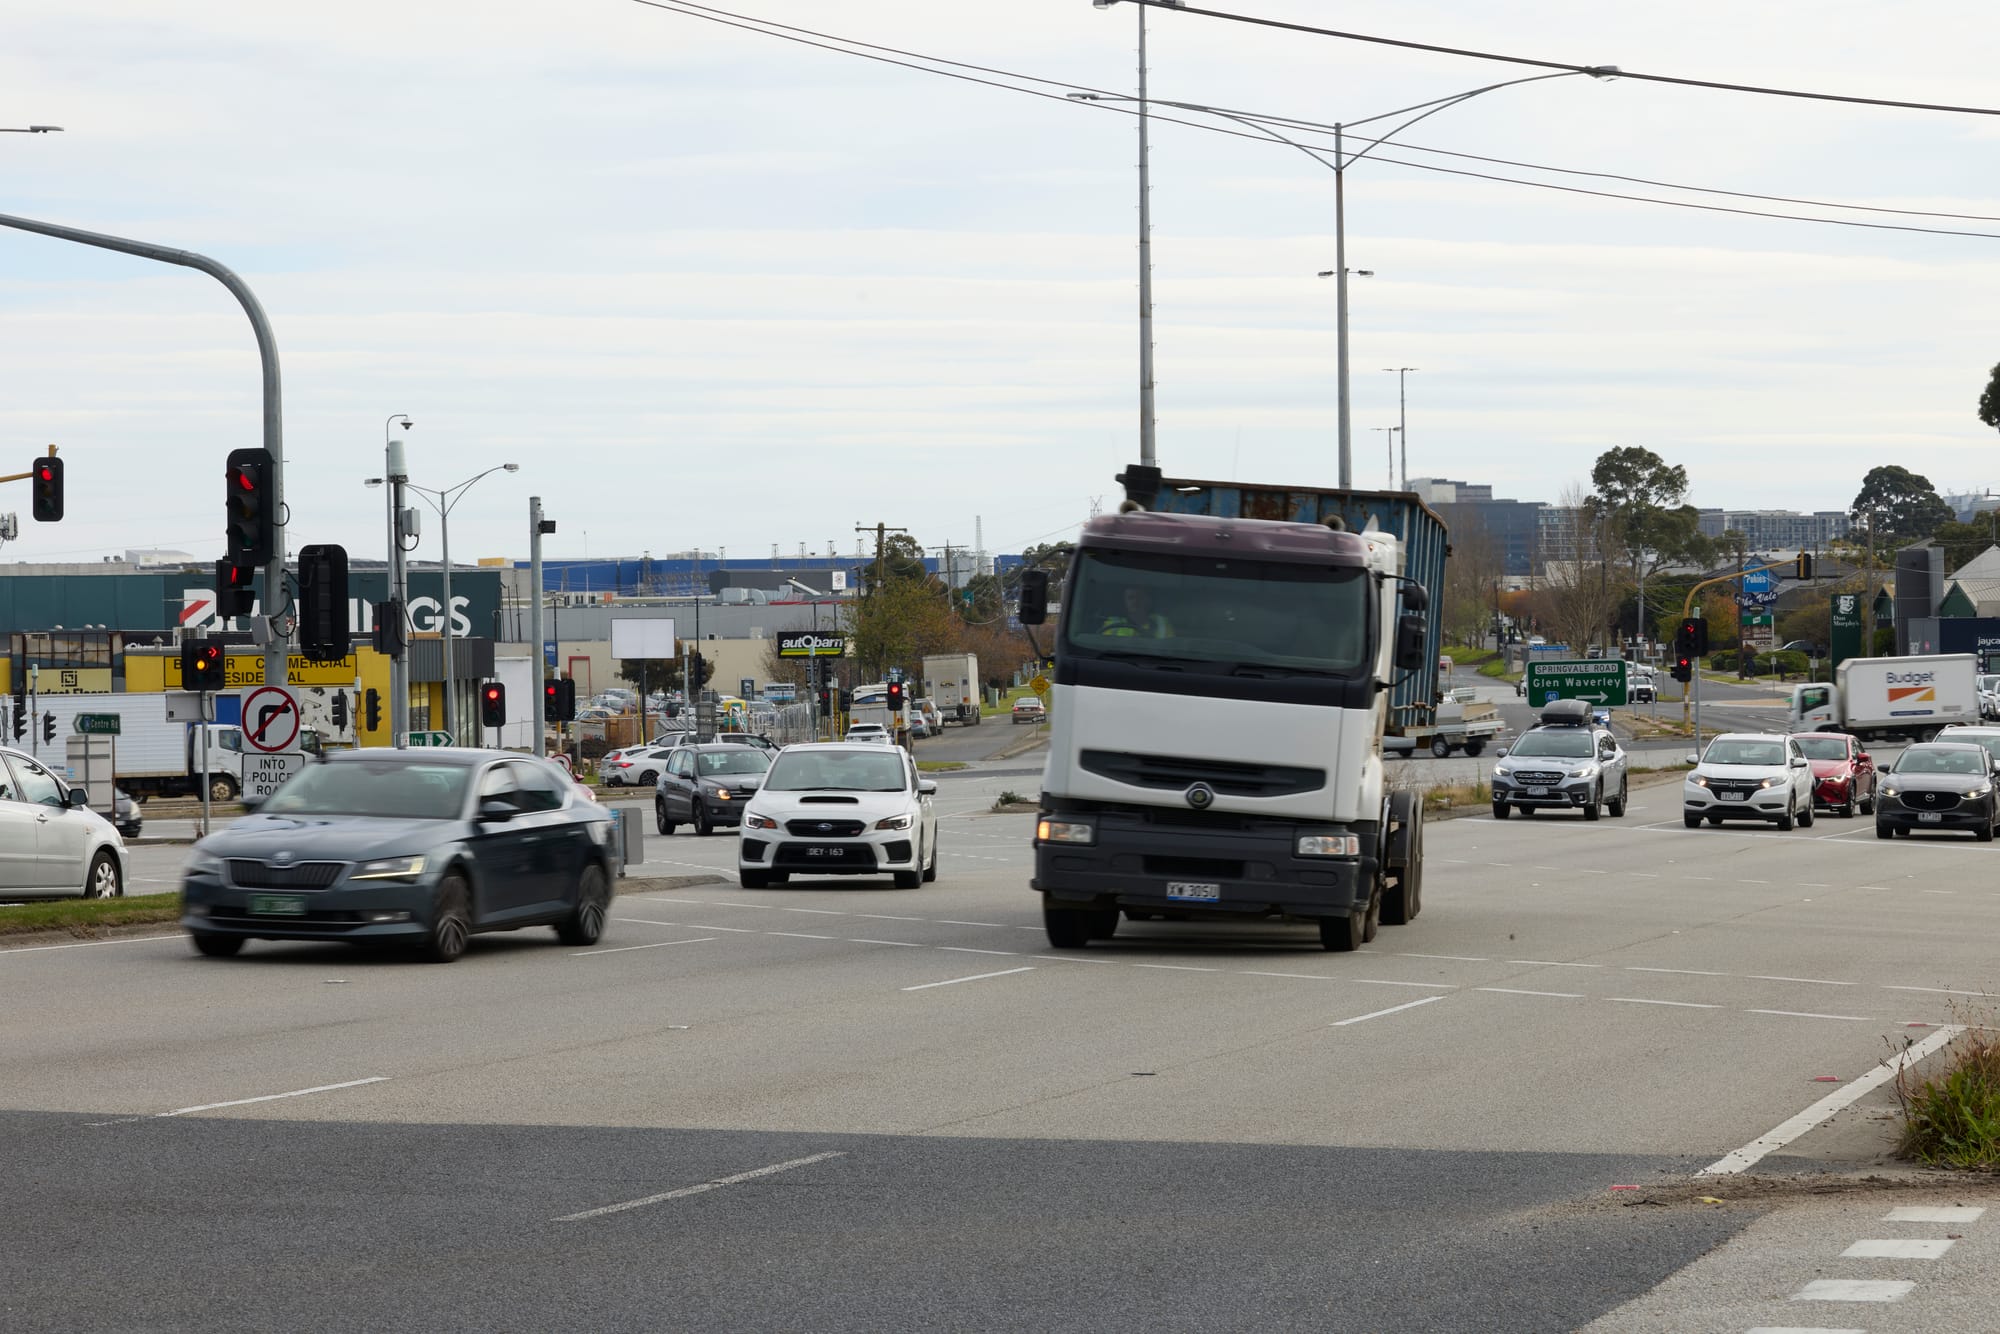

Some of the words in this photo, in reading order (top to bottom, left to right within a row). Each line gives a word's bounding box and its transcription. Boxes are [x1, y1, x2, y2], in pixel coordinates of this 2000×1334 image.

[1536, 664, 1590, 674] SPRINGVALE
[1593, 664, 1617, 673] ROAD
[1532, 678, 1560, 688] Glen
[1564, 677, 1622, 688] Waverley
[1886, 671, 1935, 686] Budget
[259, 759, 286, 770] INTO
